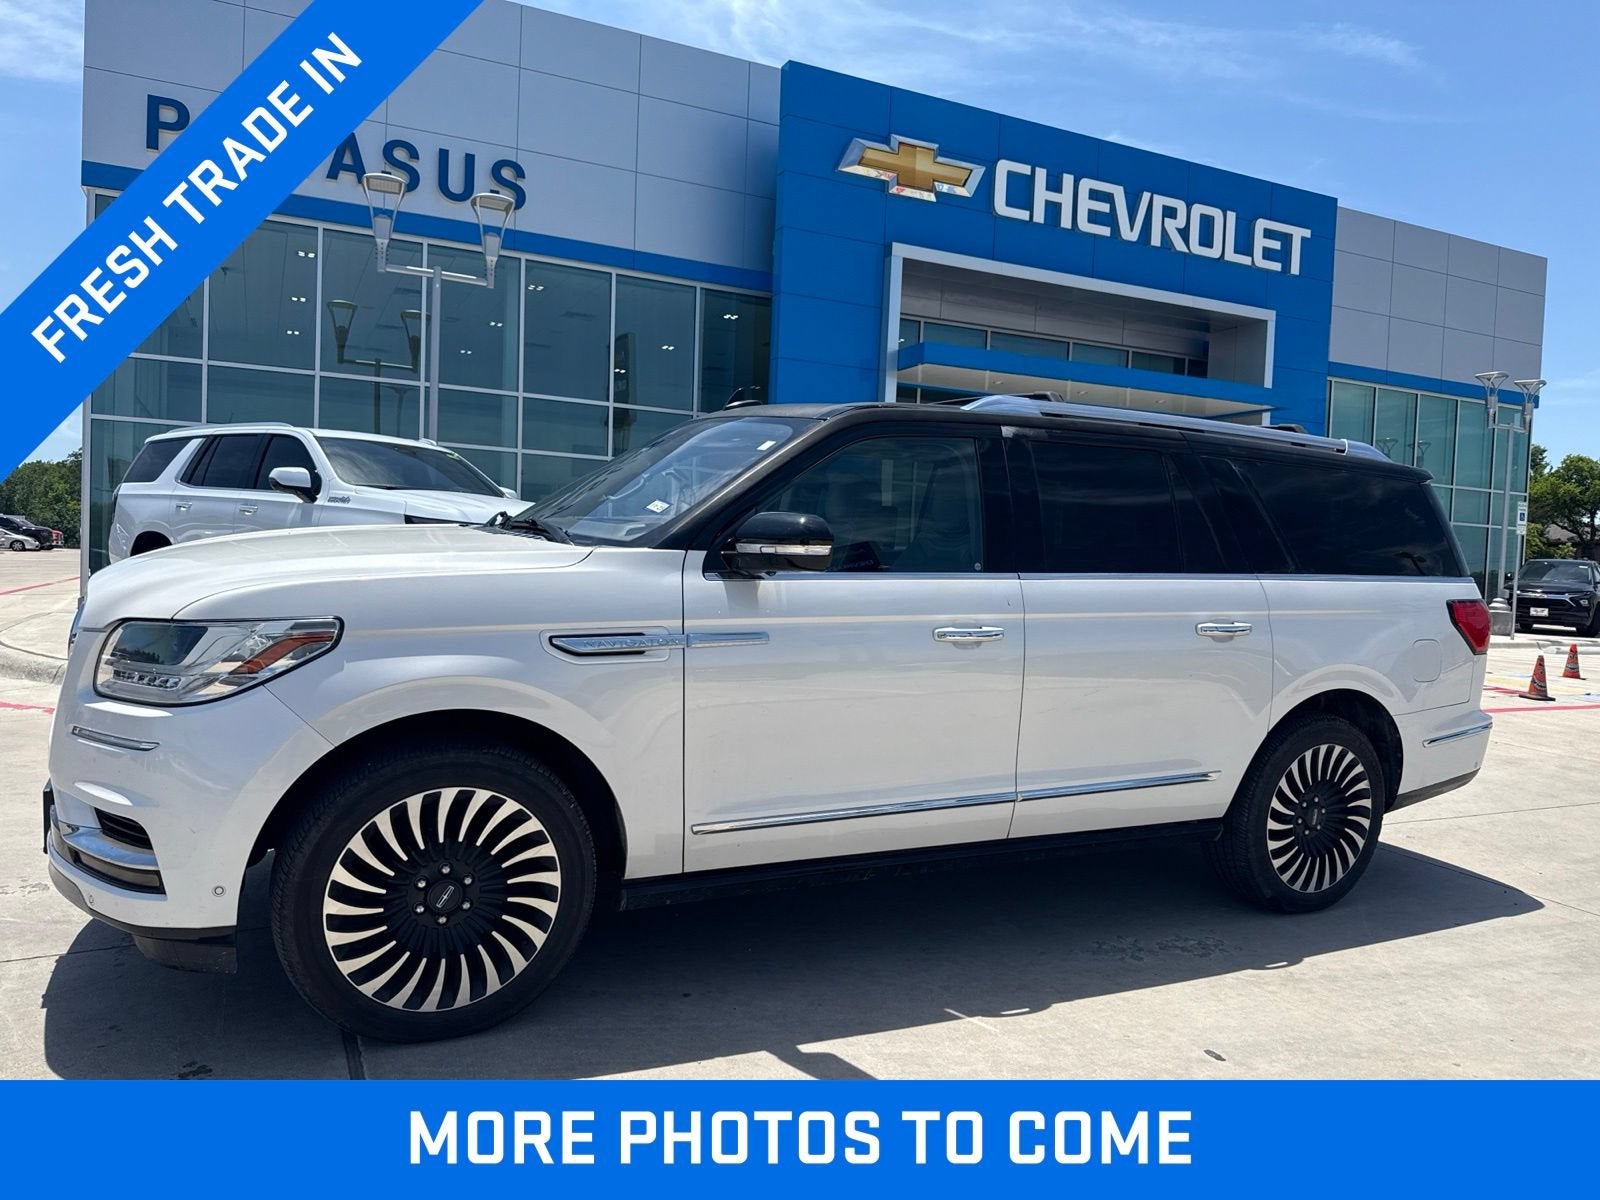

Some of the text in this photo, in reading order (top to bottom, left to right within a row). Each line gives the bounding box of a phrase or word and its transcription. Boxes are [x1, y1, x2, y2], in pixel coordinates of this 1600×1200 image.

[146, 94, 526, 210] PASUS
[993, 159, 1311, 276] CHEVROLET
[584, 638, 679, 649] NAVIGATOR
